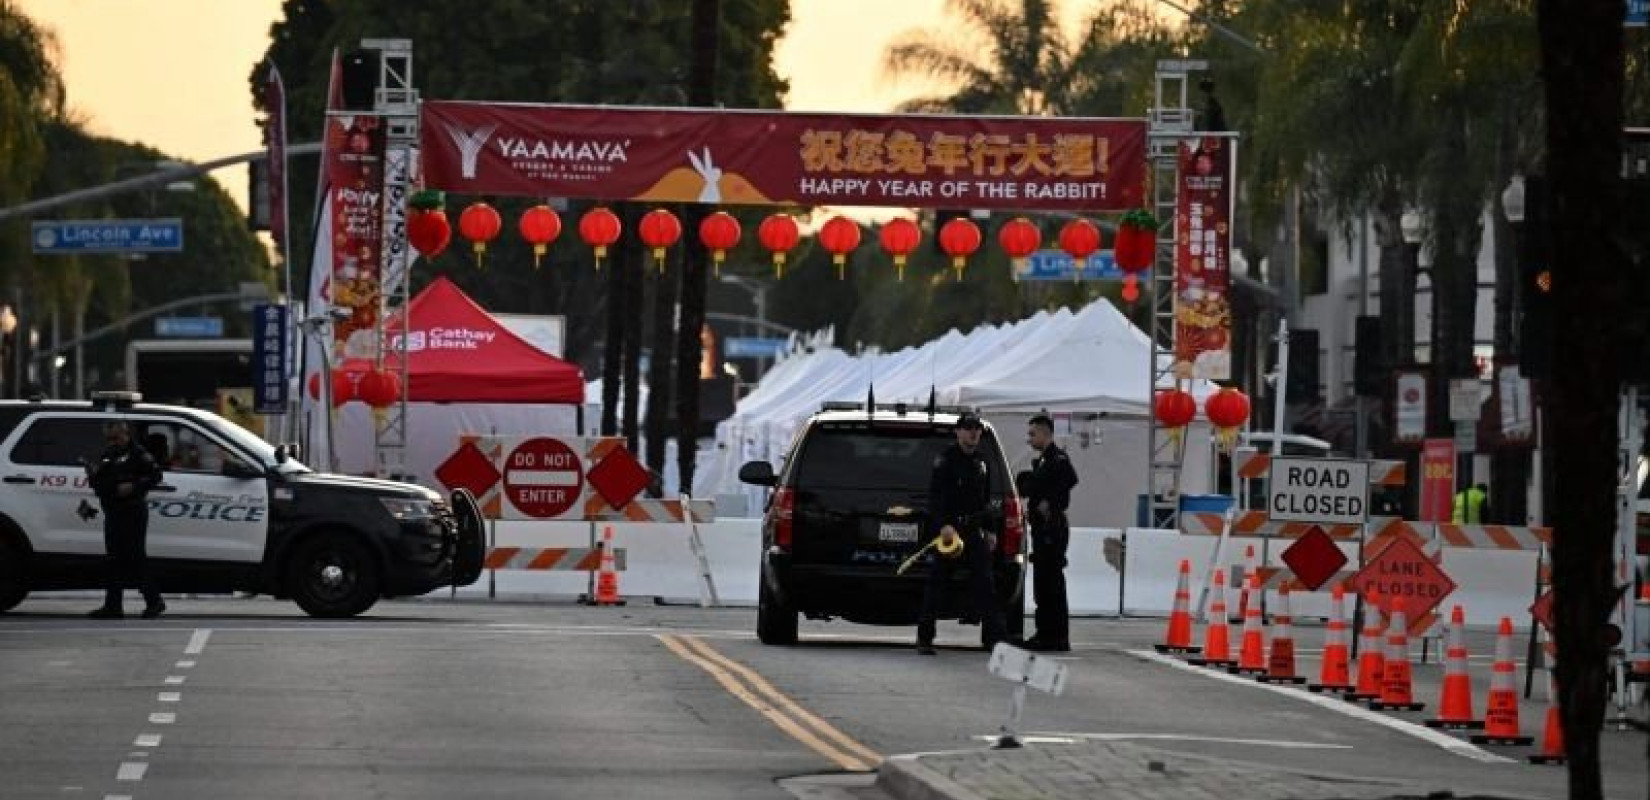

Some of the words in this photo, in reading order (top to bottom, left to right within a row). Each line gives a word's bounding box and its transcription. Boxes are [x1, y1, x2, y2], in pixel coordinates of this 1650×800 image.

[800, 177, 870, 195] HAPPY
[878, 179, 933, 197] YEAR
[940, 180, 970, 198] OF
[975, 181, 1018, 199] THE
[1024, 182, 1107, 199] RABBIT!
[62, 225, 131, 241] Lincoln
[139, 224, 173, 240] Ave
[429, 327, 496, 342] Cathay
[430, 337, 477, 349] Bank
[515, 452, 536, 467] DO
[543, 453, 572, 467] NOT
[40, 475, 67, 487] K9
[1288, 466, 1350, 488] ROAD
[519, 488, 565, 504] ENTER
[1274, 492, 1362, 516] CLOSED
